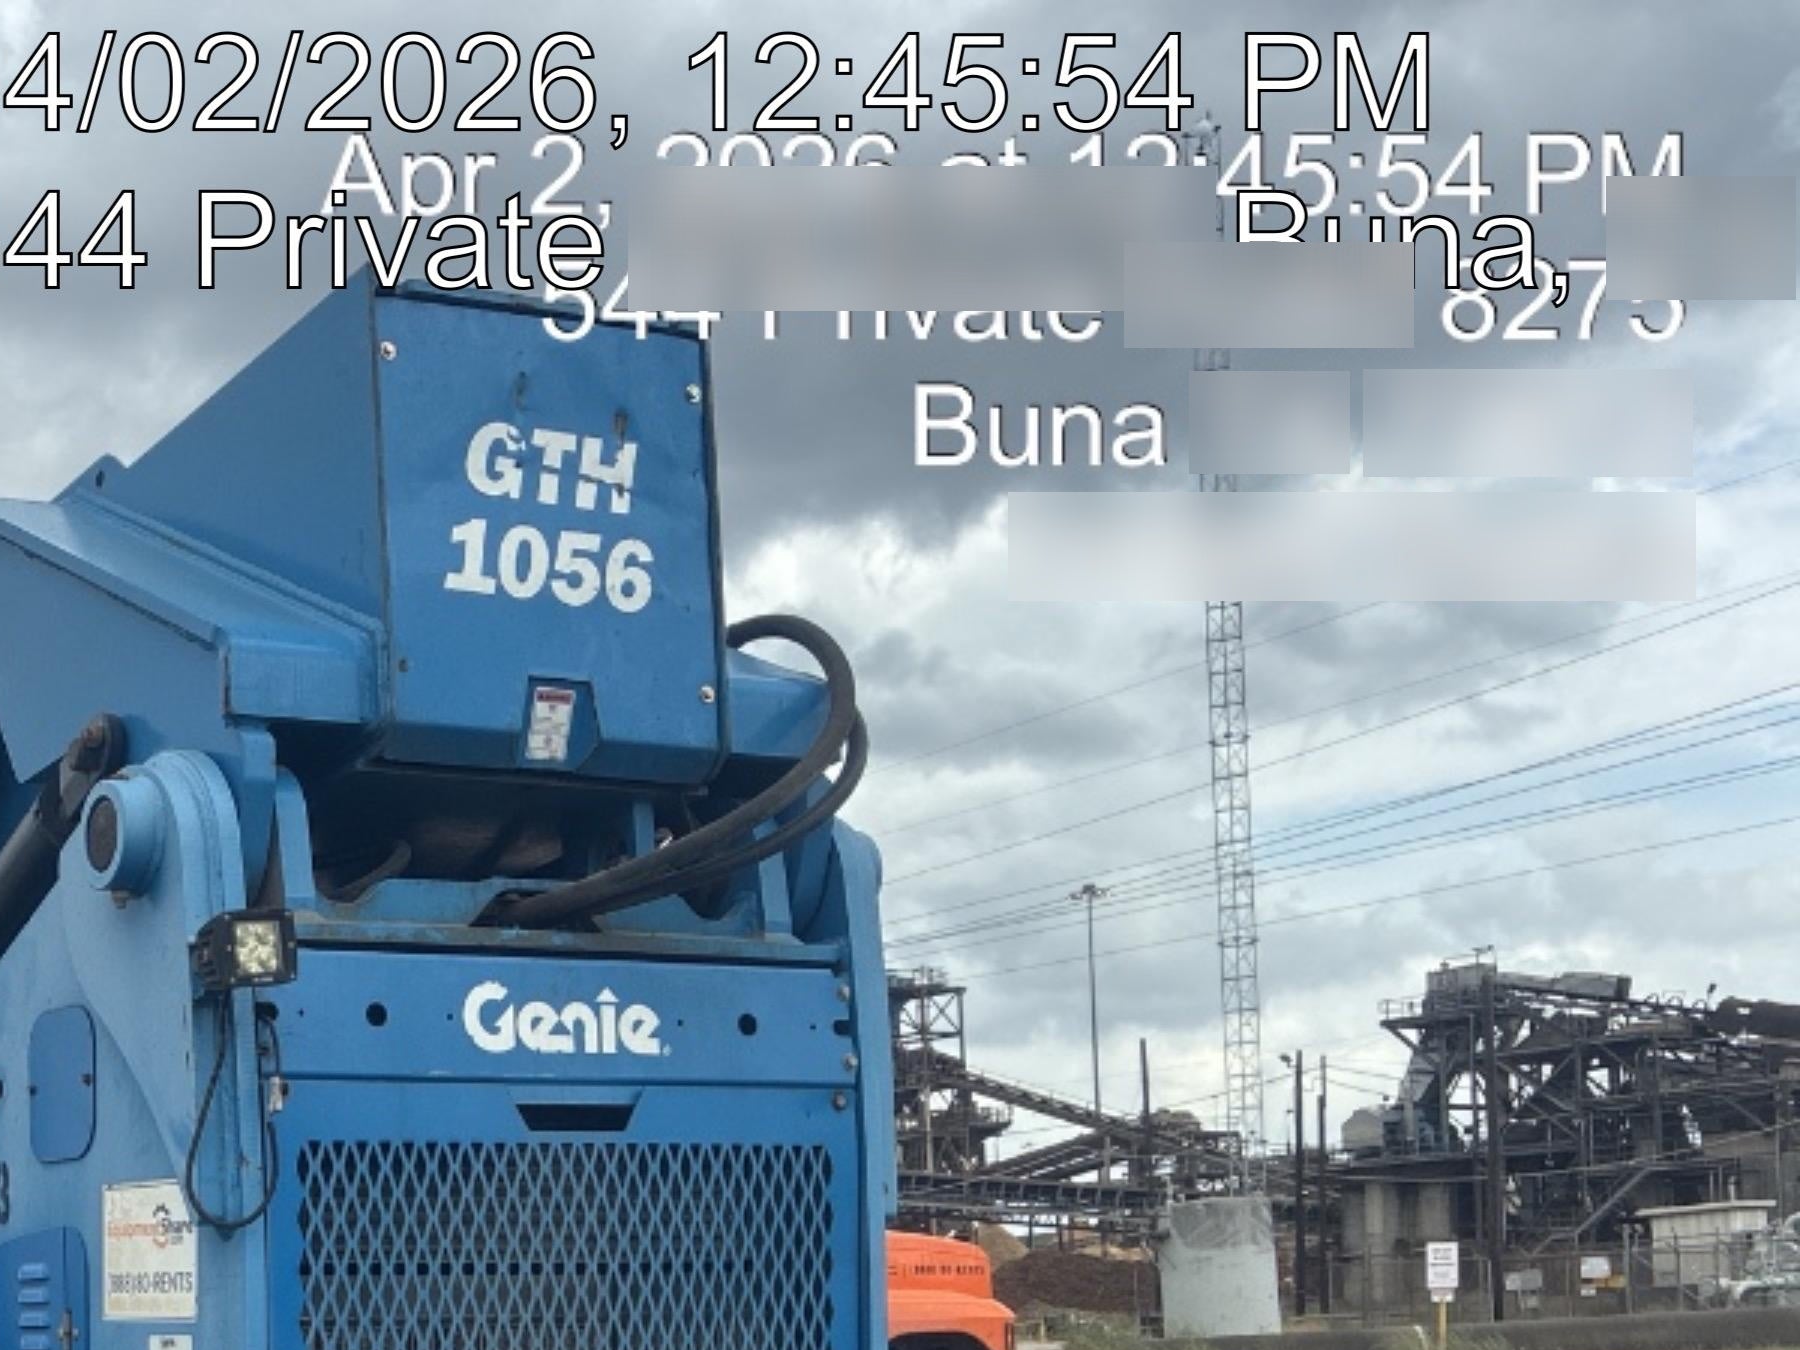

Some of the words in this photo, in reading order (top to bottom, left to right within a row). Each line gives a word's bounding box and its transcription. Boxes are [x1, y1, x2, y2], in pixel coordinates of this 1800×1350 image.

[464, 421, 638, 515] GTH
[443, 518, 655, 614] 1056
[463, 980, 662, 1055] Genie
